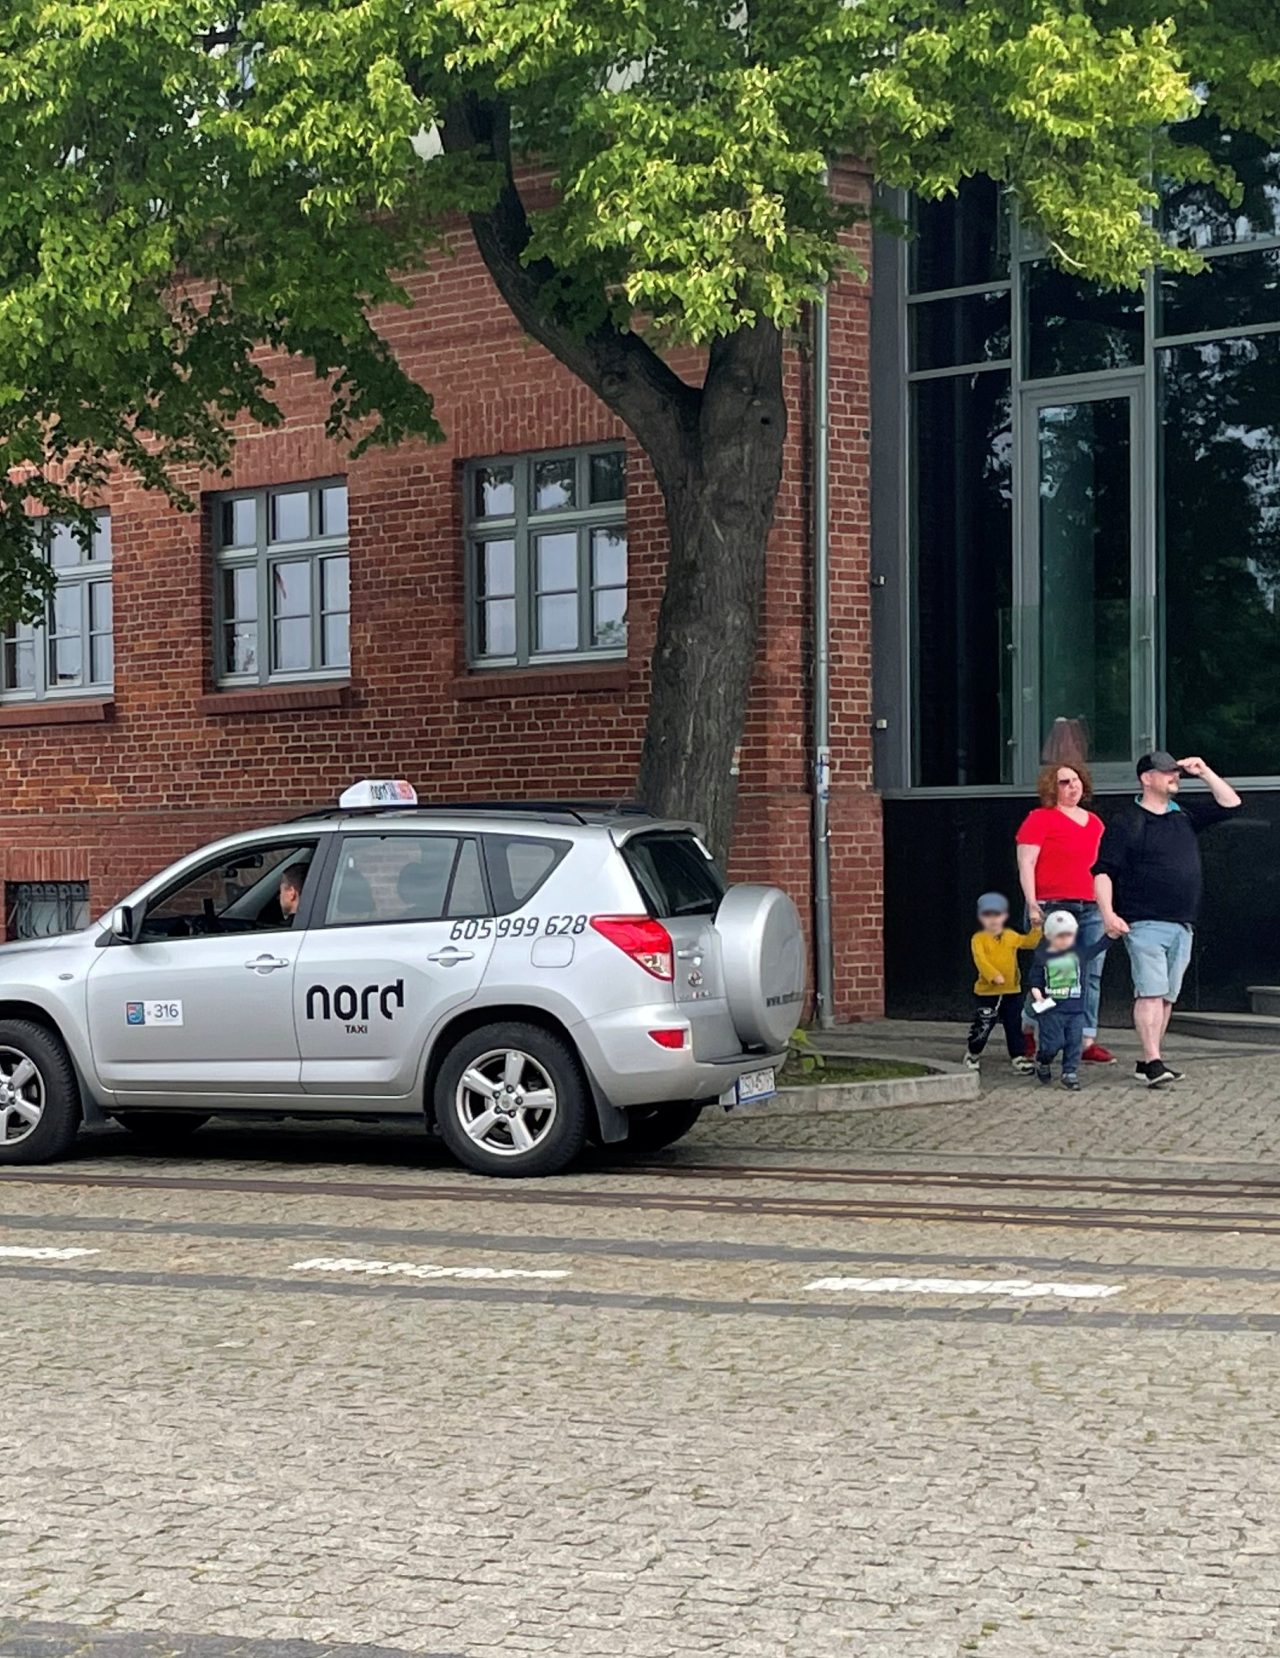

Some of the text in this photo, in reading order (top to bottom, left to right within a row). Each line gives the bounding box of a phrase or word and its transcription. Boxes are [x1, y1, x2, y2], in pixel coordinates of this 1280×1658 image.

[450, 915, 587, 940] 605 999 628
[306, 979, 404, 1020] nord
[154, 1003, 179, 1018] 316
[345, 1025, 368, 1034] TAXI
